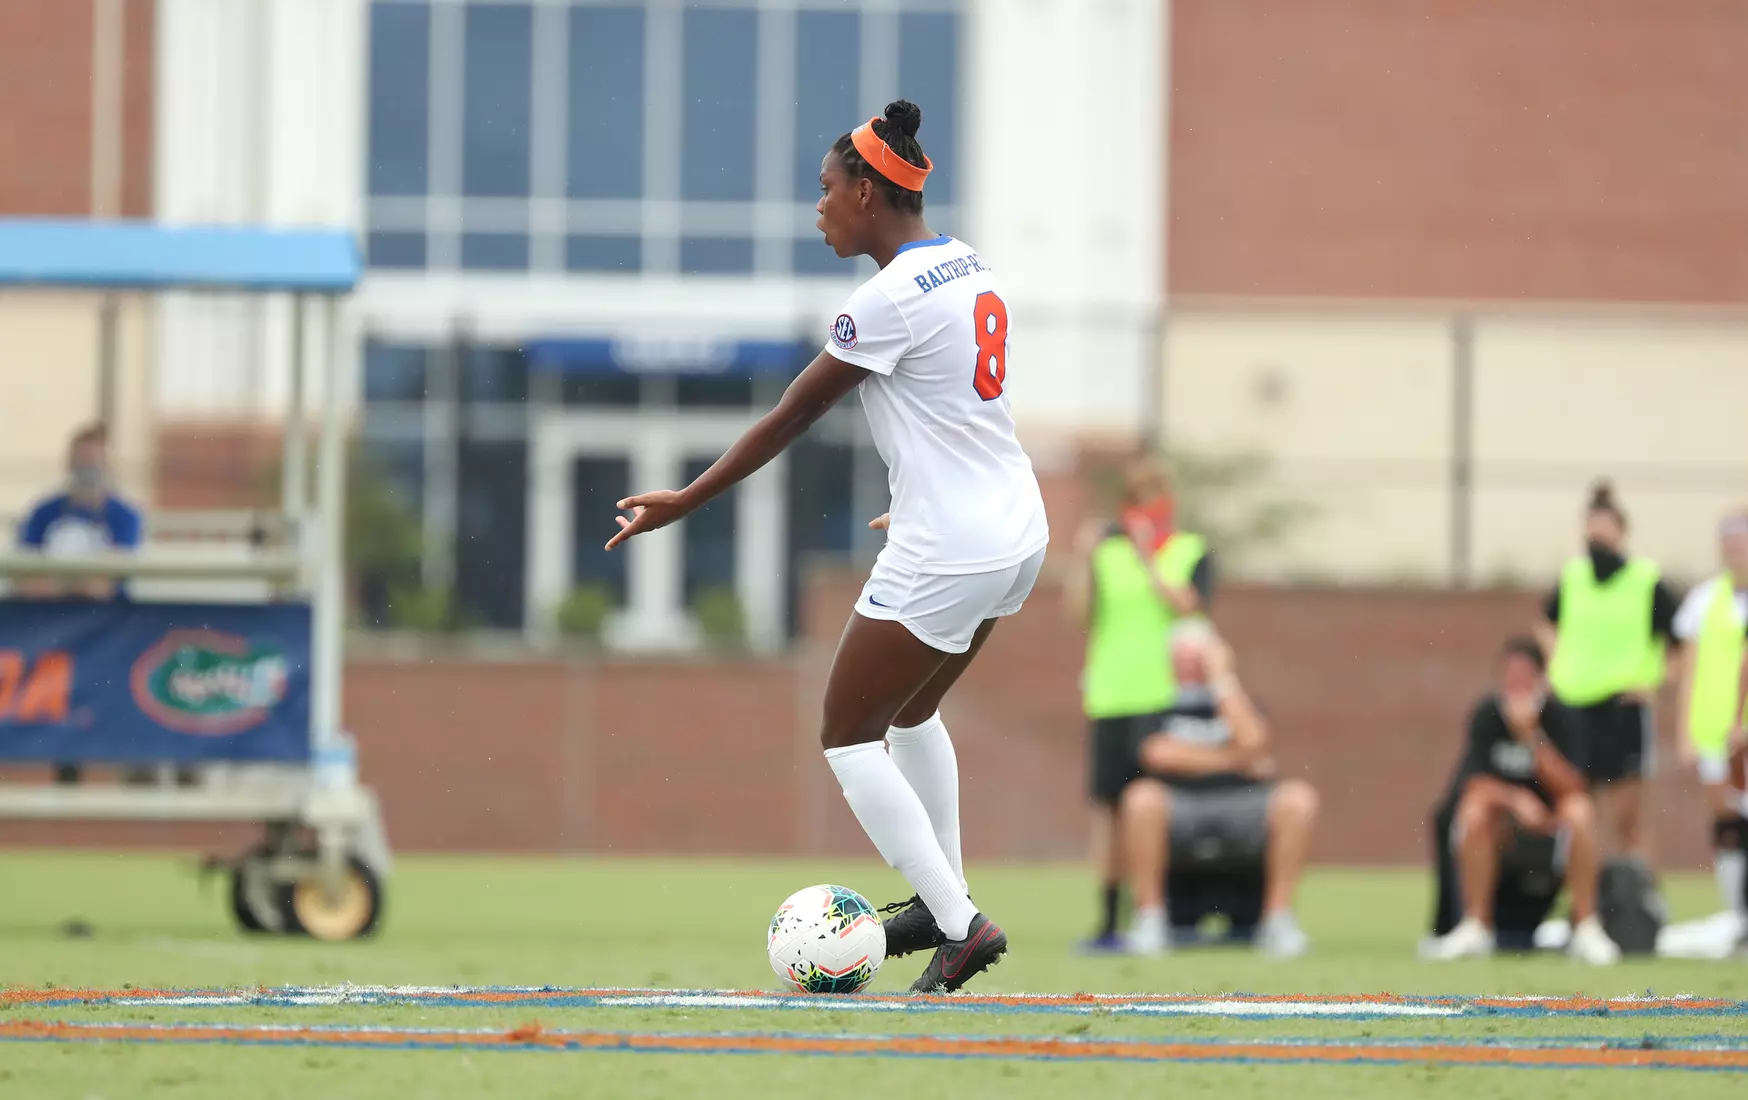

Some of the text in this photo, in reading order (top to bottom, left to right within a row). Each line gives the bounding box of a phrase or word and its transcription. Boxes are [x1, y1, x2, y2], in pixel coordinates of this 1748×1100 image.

[914, 253, 991, 293] BALTRIP-R
[836, 316, 854, 341] SEC
[973, 290, 1008, 401] 8
